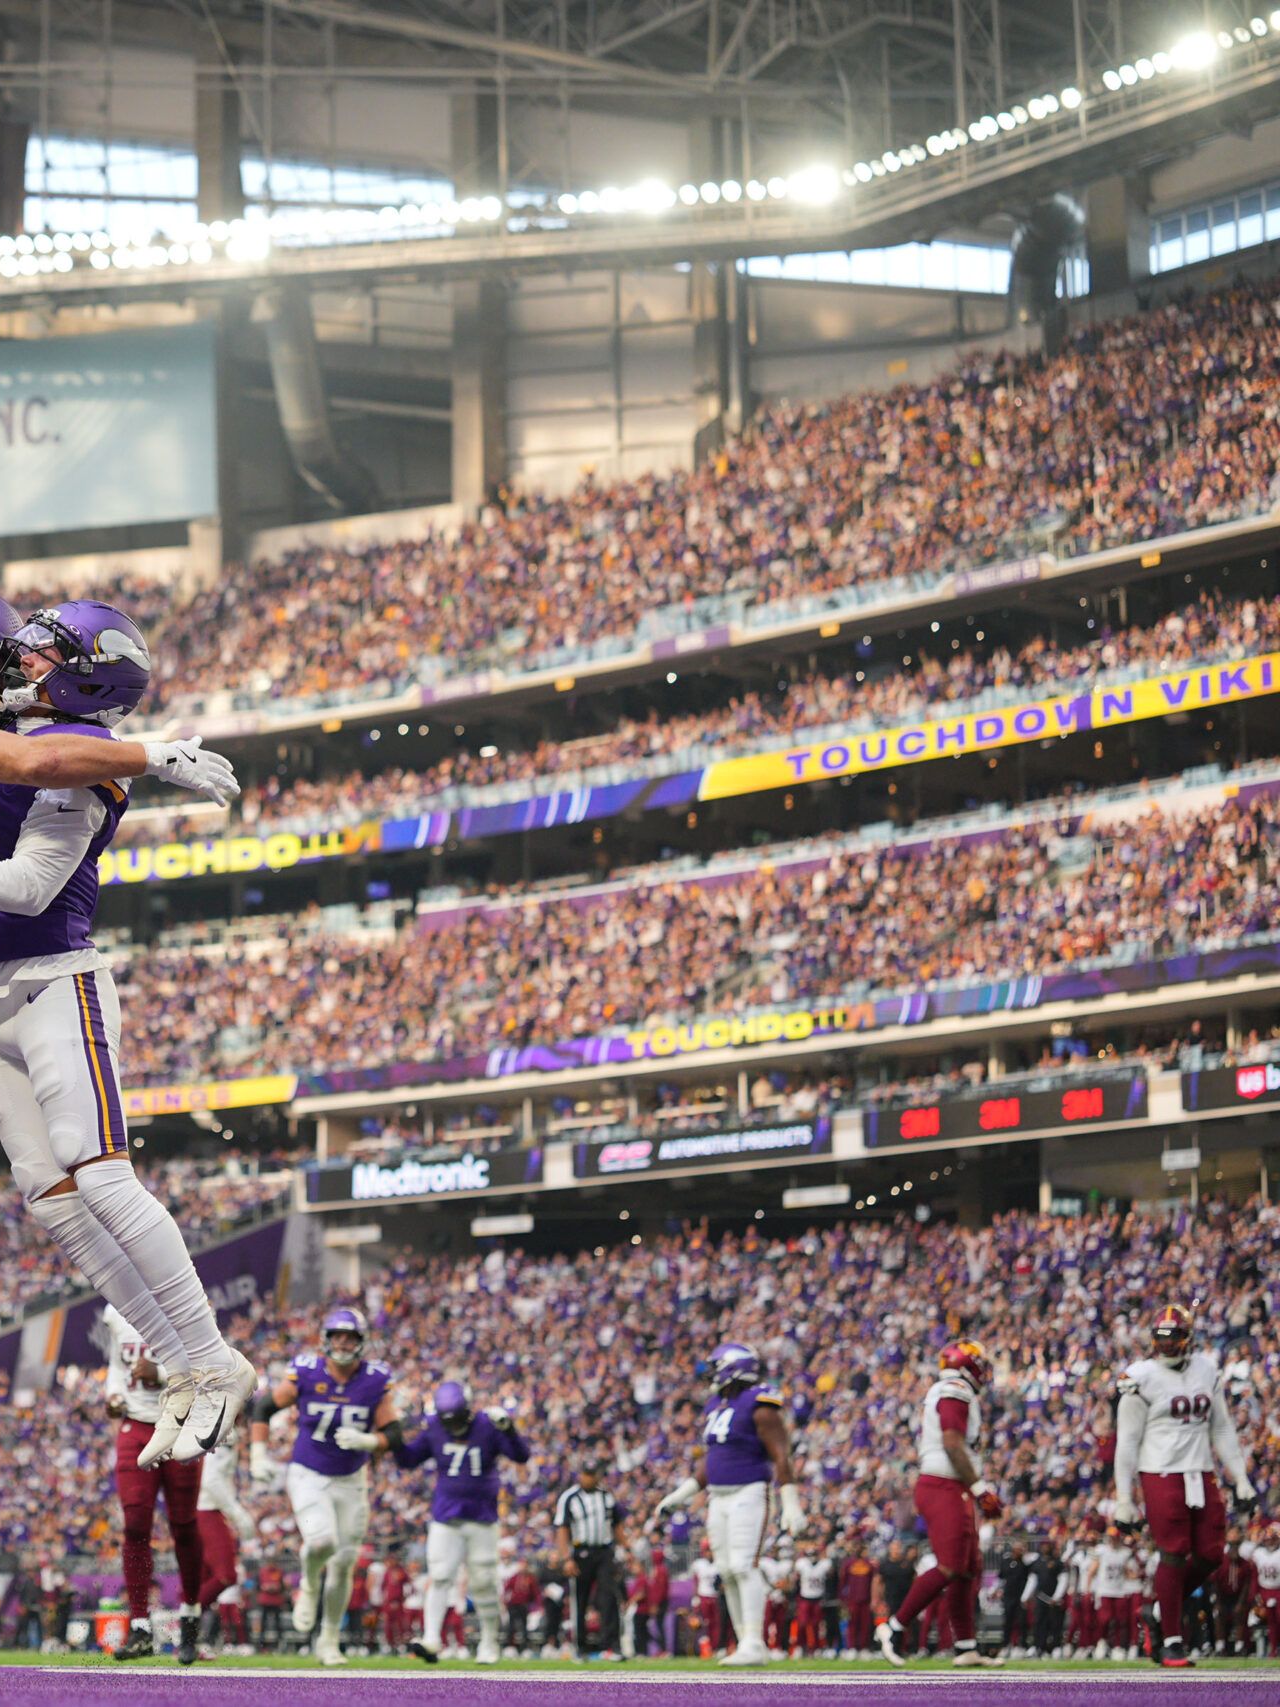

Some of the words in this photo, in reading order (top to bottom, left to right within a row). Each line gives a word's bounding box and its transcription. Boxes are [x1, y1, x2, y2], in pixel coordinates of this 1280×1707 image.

[979, 1098, 1020, 1130] 3M
[1061, 1088, 1103, 1120] 3M
[900, 1107, 940, 1139] 3M
[351, 1153, 489, 1199] Medtronic
[307, 1402, 369, 1442] 75
[442, 1442, 482, 1476] 71
